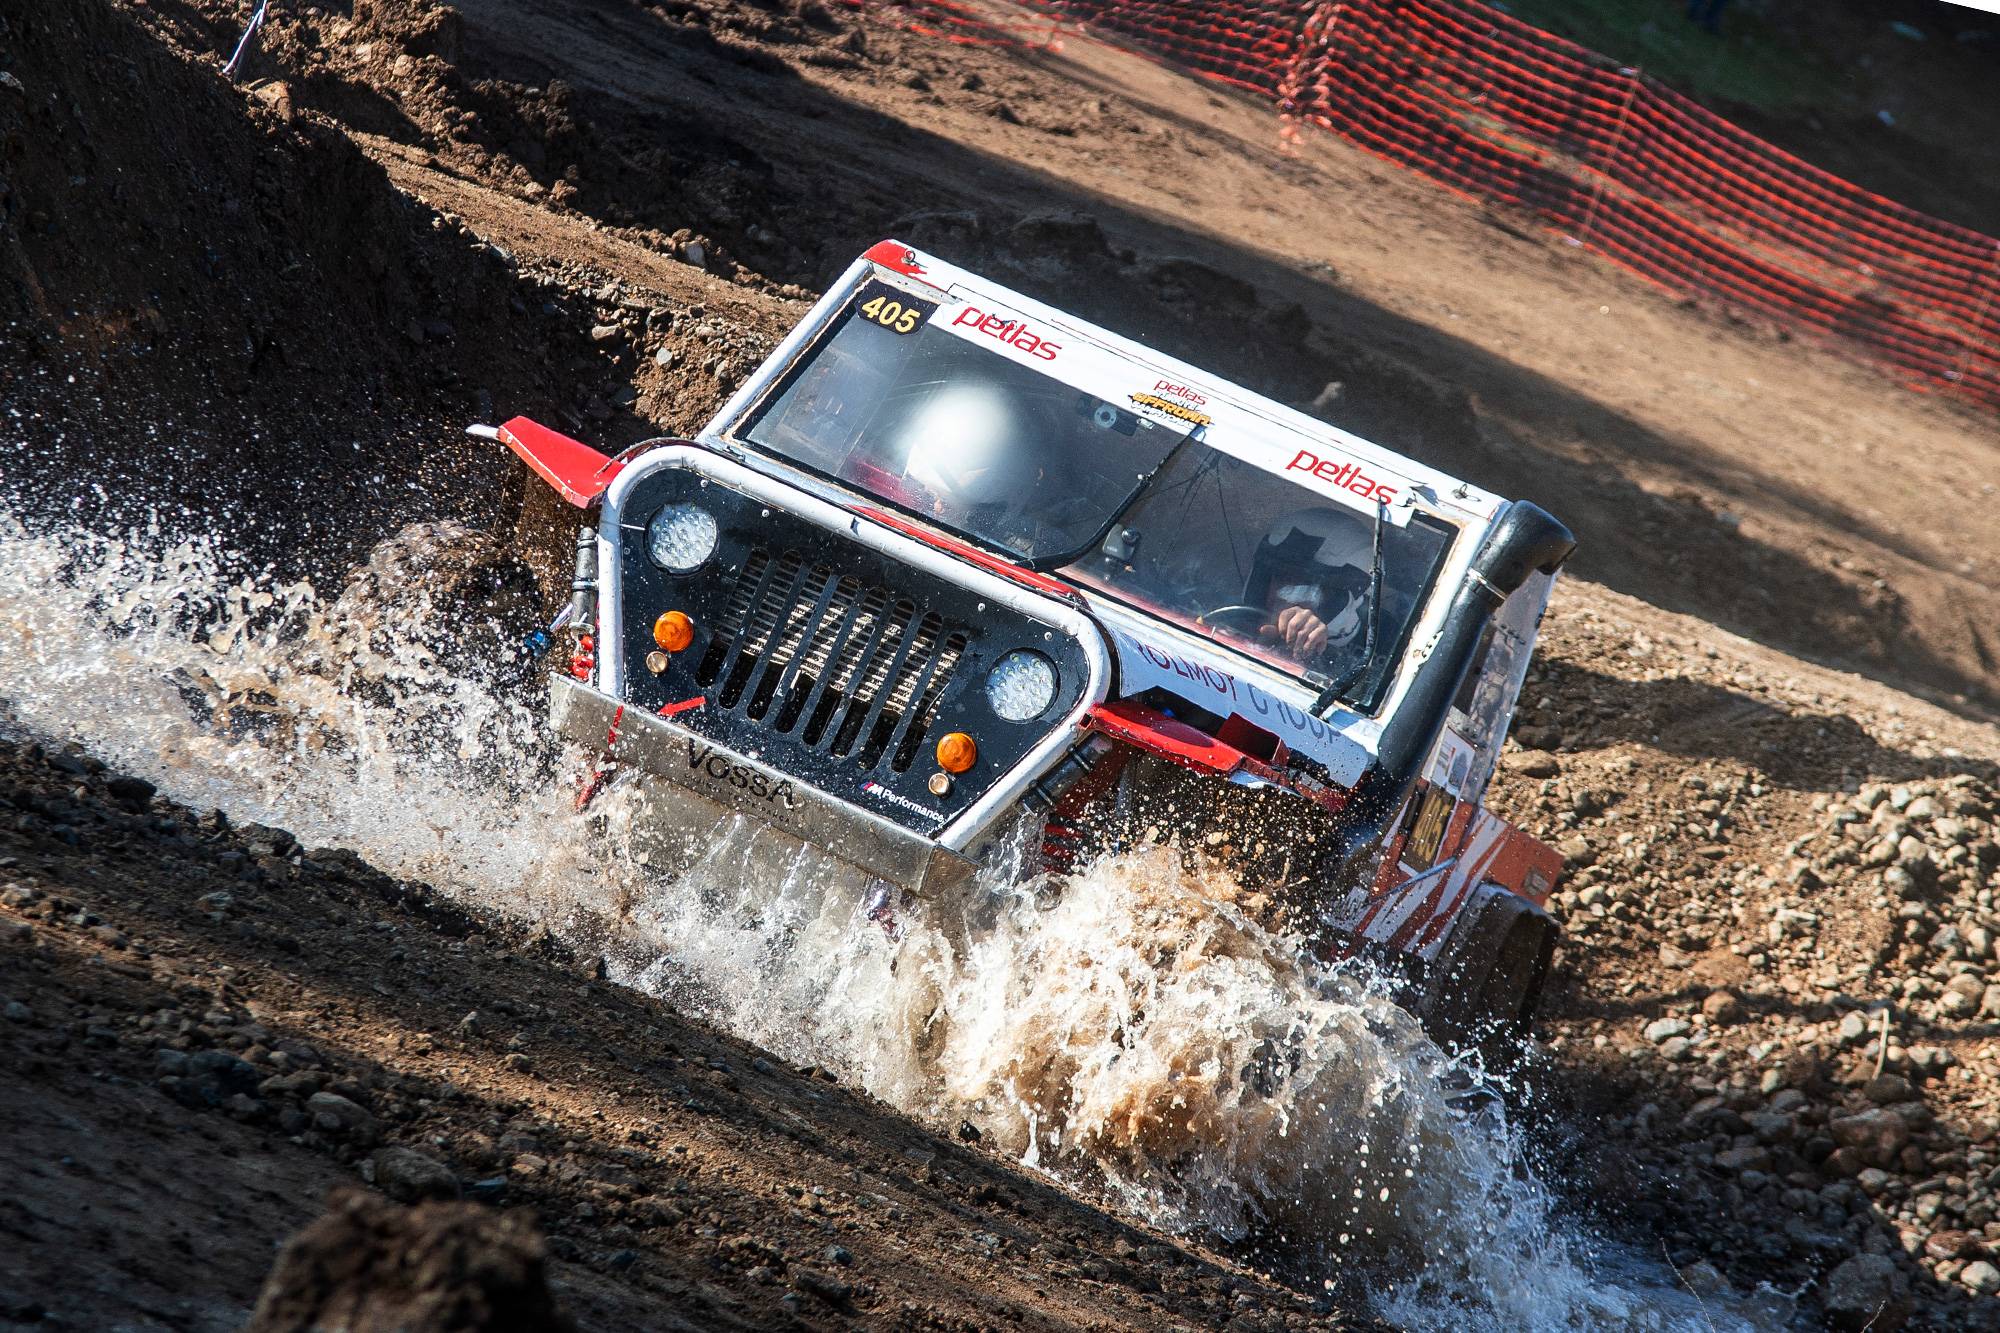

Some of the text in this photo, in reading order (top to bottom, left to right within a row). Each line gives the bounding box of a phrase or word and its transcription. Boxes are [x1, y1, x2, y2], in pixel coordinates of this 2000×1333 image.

[861, 296, 921, 333] 405
[952, 306, 1063, 361] petlas
[1153, 380, 1209, 406] petlas
[1285, 449, 1399, 506] petlas
[688, 737, 795, 813] VOSSA
[882, 788, 944, 823] Performance
